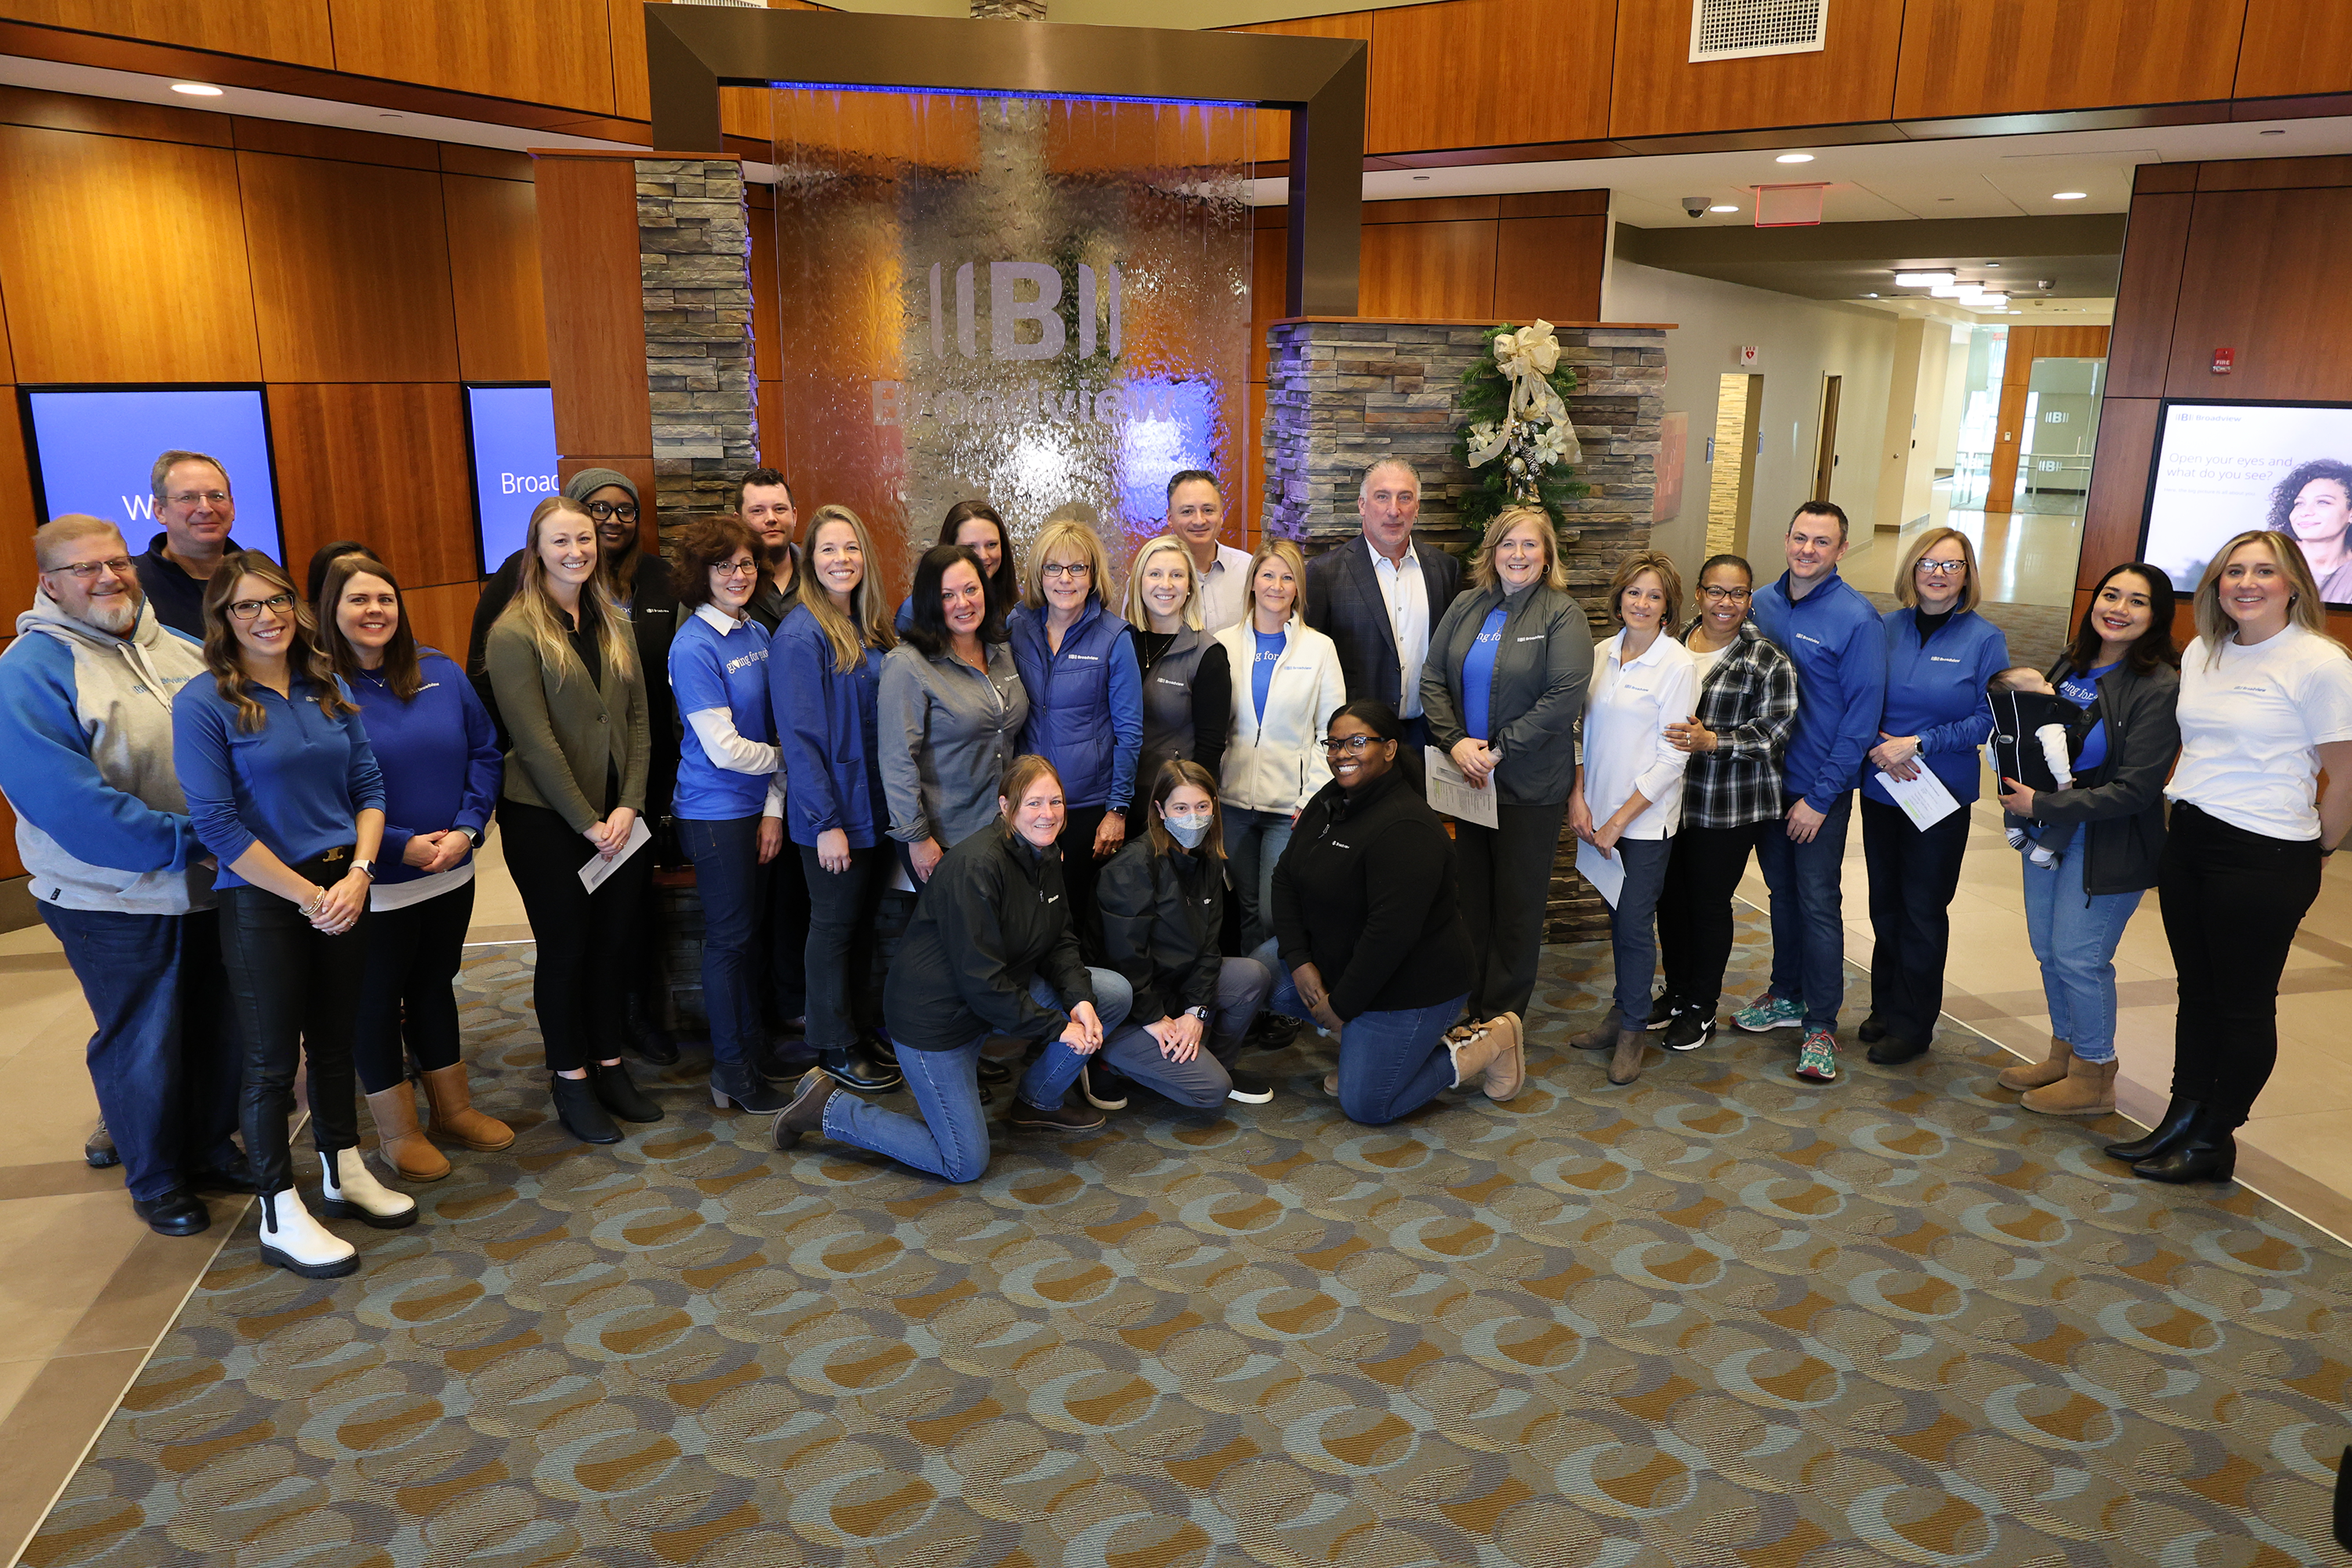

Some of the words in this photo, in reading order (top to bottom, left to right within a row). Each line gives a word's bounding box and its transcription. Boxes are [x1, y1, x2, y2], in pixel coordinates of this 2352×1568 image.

[872, 379, 1175, 425] Broadview
[2169, 452, 2202, 465] Open
[2205, 456, 2234, 466] your
[2237, 456, 2264, 468] eyes
[2267, 457, 2293, 467] and
[2167, 467, 2196, 477] what
[2199, 468, 2216, 478] do
[2218, 471, 2241, 481] you
[2245, 470, 2273, 481] see?
[749, 651, 760, 662] for
[1263, 650, 1279, 661] for
